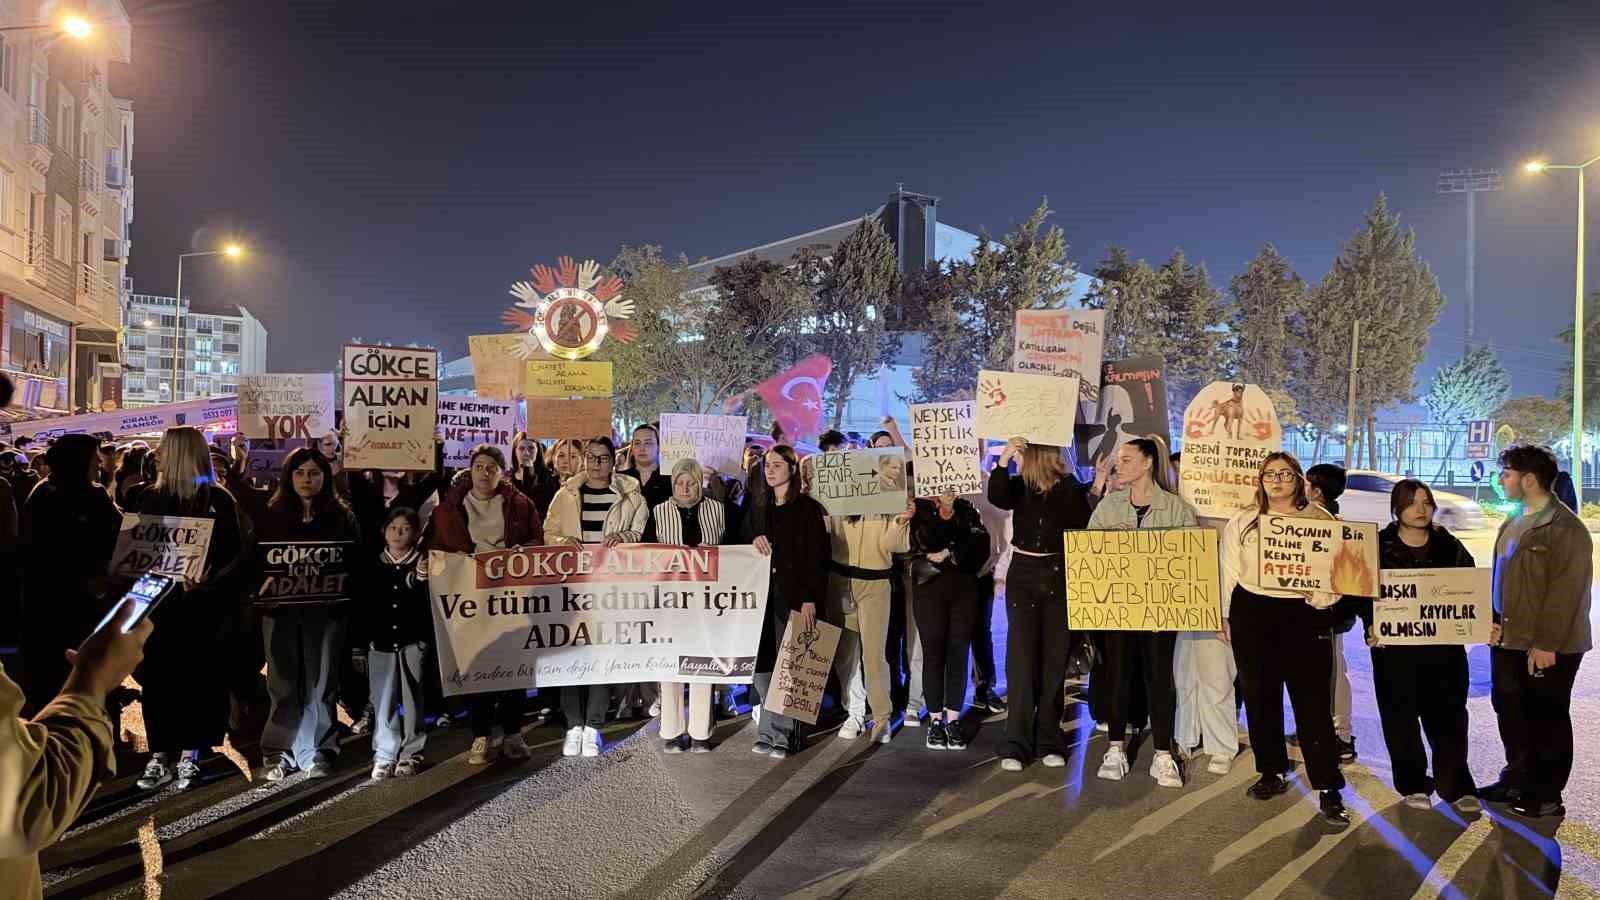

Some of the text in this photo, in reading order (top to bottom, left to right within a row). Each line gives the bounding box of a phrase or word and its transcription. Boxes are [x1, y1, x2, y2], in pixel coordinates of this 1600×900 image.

[350, 348, 430, 379] GÖKÇE
[349, 385, 429, 407] ALKAN
[368, 409, 410, 432] İÇİN
[914, 404, 971, 423] NEYSEKİ
[263, 415, 311, 441] YOK
[913, 425, 974, 443] EŞİTLİK
[1470, 421, 1487, 442] H
[1184, 441, 1274, 459] BEDENİ TOPRAĞ
[935, 459, 955, 474] YA
[1192, 456, 1220, 467] SUÇU
[1182, 466, 1260, 487] GÖMÜLECE
[1270, 517, 1332, 539] SAÇININ
[266, 545, 344, 568] GÖKÇE
[484, 547, 712, 582] GÖKÇE ALKAN
[1263, 550, 1306, 563] KENTİ
[288, 564, 320, 577] İÇİN
[1066, 556, 1131, 581] KADAR
[1263, 562, 1312, 577] ATEŞE
[258, 575, 347, 597] ADALET
[1380, 583, 1417, 601] BAŞKA
[439, 584, 759, 620] Ve tüm kadınlar için
[1419, 604, 1477, 620] KAYIPLAR
[1068, 606, 1219, 630] KADAR ADAMSIN
[522, 619, 673, 650] ADALET...
[1380, 621, 1437, 637] OLMASIN
